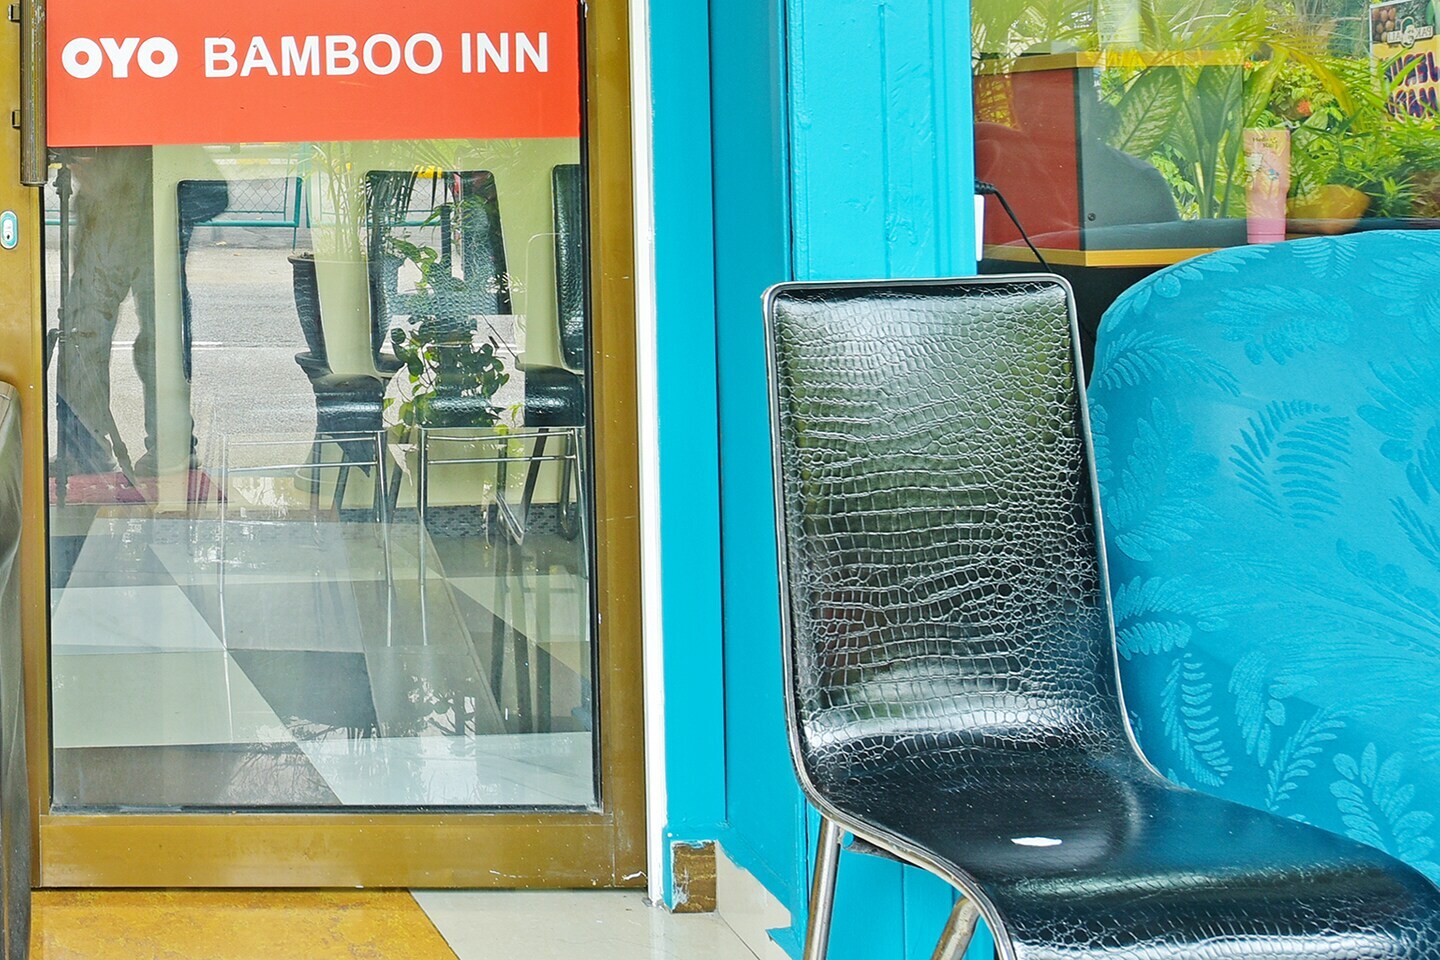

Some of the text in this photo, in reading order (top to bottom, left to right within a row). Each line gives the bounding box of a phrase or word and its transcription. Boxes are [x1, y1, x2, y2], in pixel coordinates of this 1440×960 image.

[61, 31, 549, 79] OYO BAMBOO INN
